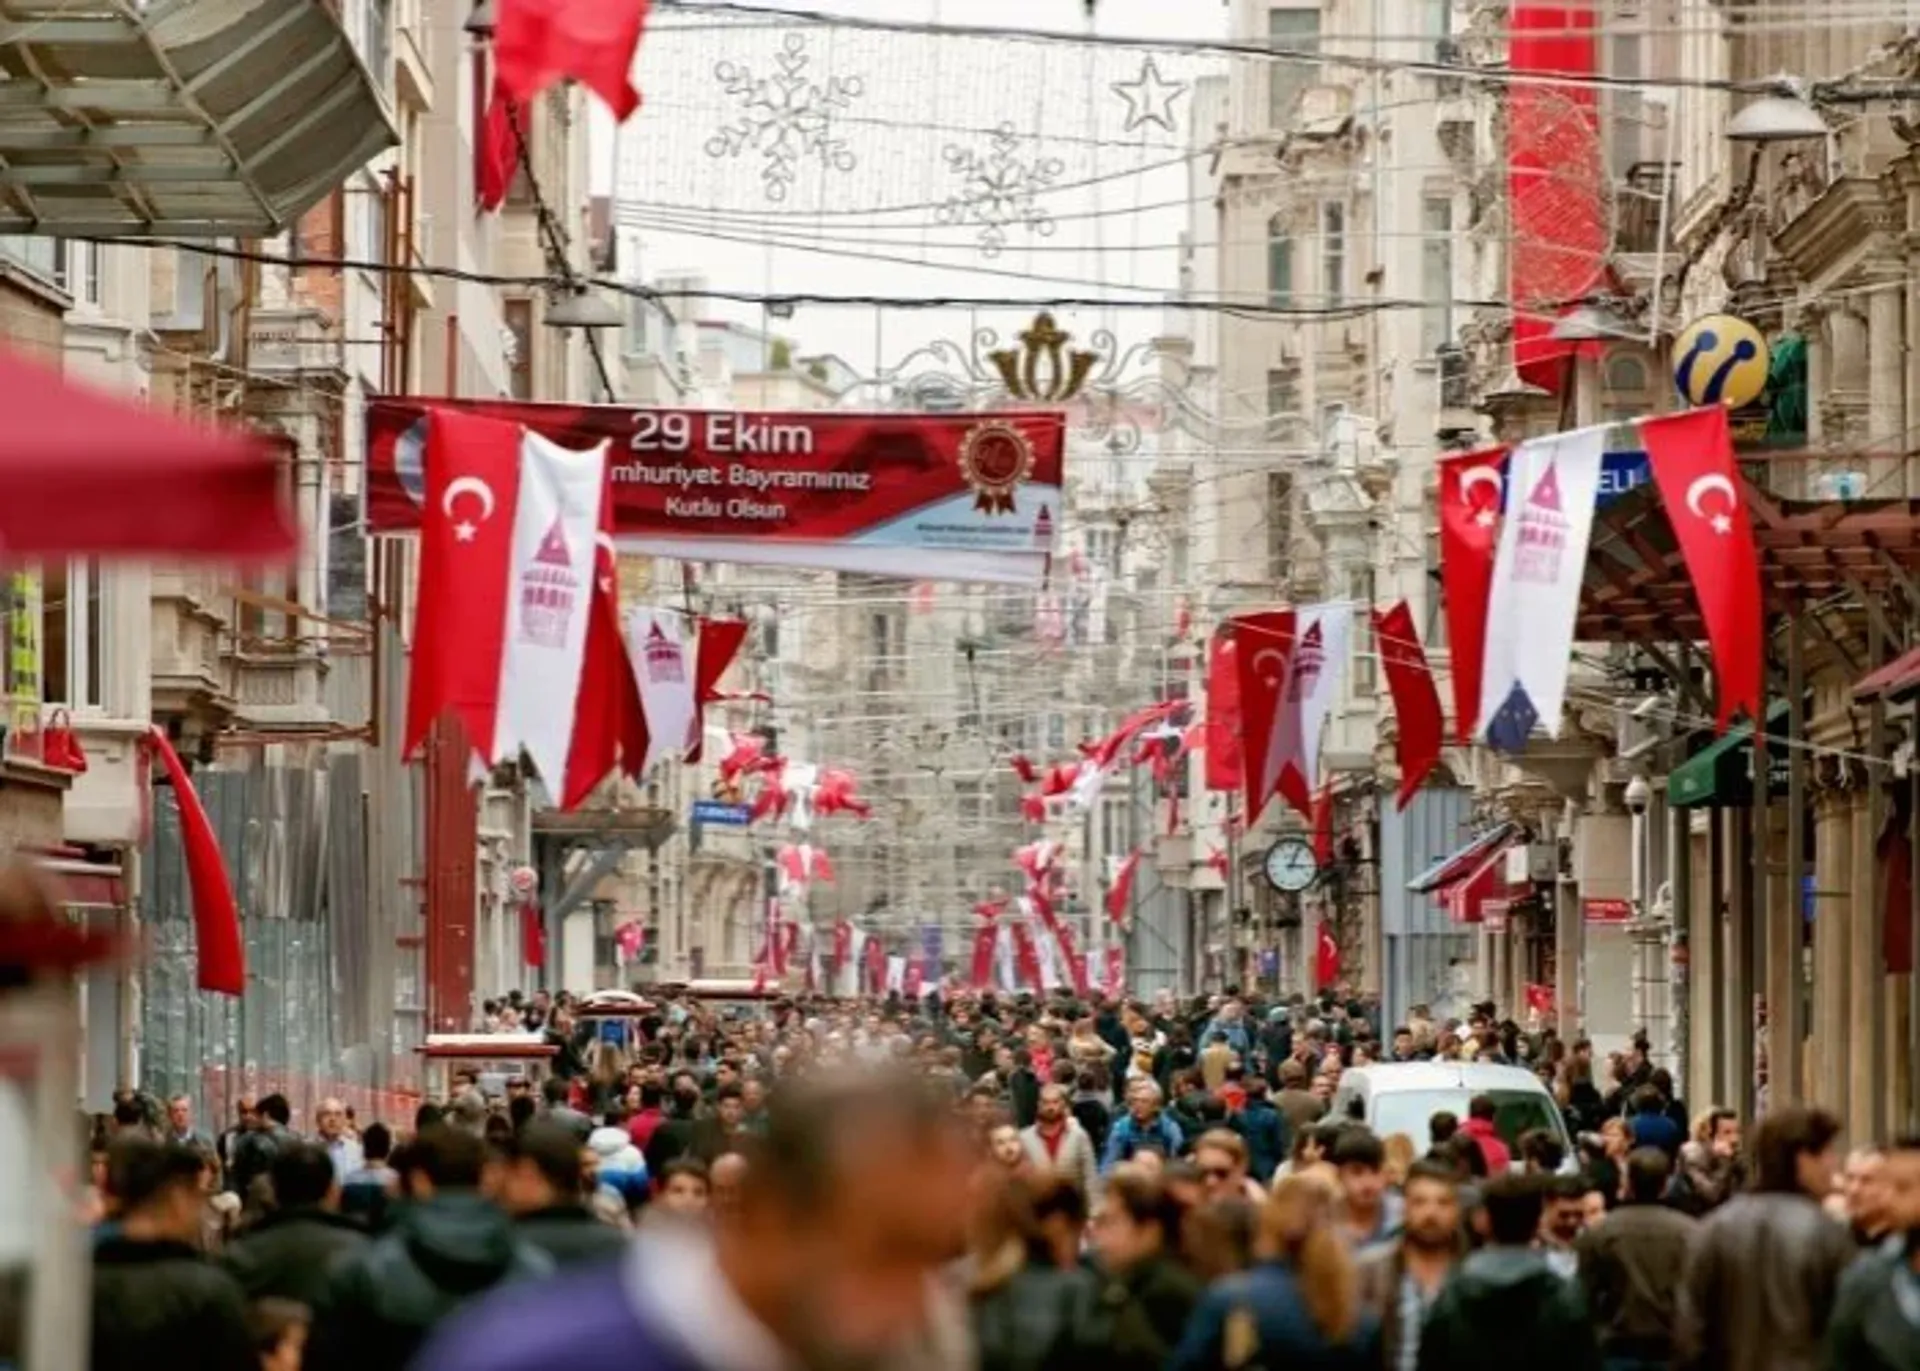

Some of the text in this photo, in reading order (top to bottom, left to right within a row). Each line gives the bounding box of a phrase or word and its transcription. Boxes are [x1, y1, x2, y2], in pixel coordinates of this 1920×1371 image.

[631, 411, 813, 454] 29 Ekim
[611, 461, 871, 492] mhuriyet Bayramımız
[665, 496, 786, 520] Kutlu Olsun
